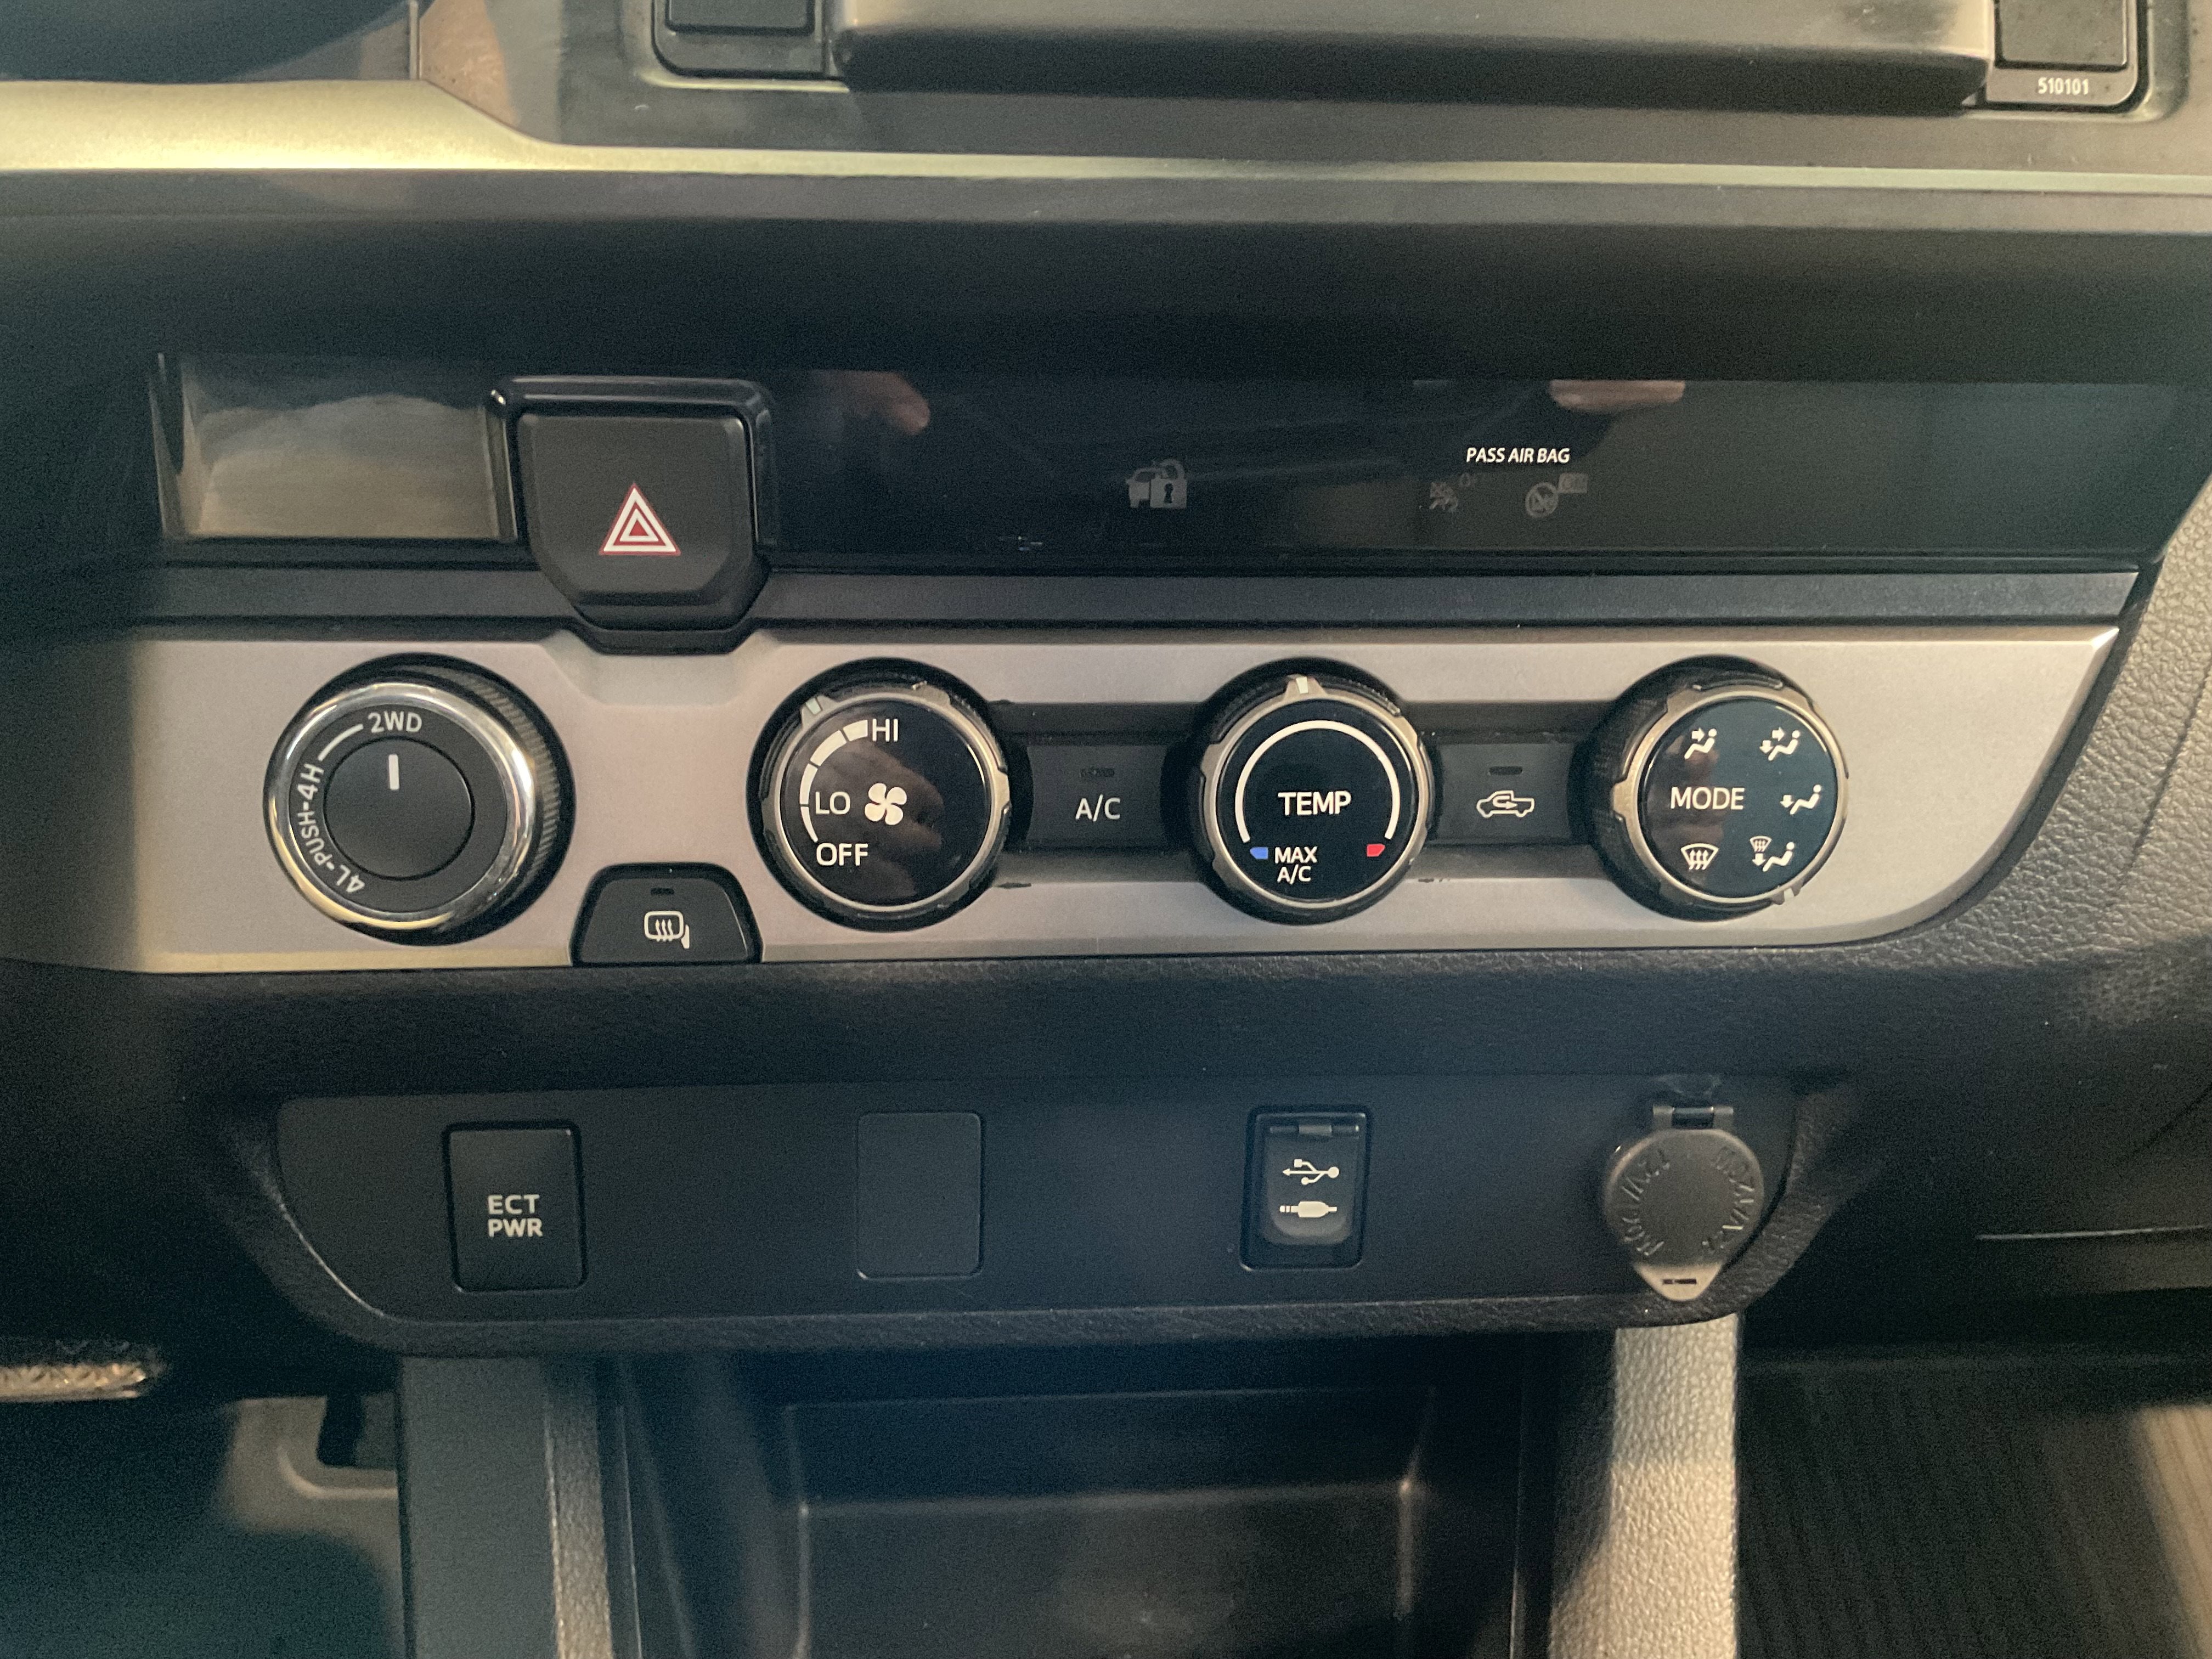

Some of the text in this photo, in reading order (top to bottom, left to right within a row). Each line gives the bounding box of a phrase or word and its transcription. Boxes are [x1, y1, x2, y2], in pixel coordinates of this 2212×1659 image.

[2037, 77, 2089, 95] 510101
[1466, 447, 1571, 464] PASS AIR BAG
[368, 711, 422, 733] 2WD
[872, 718, 899, 742] HI
[815, 791, 851, 815] LO
[1075, 793, 1121, 822] A/C
[1277, 790, 1352, 816] TEMP
[1670, 786, 1745, 810] MODE
[815, 842, 868, 866] OFF
[1274, 846, 1318, 864] MAX
[1277, 864, 1312, 885] A/C
[487, 1194, 540, 1215] ECT
[488, 1217, 543, 1238] PWR
